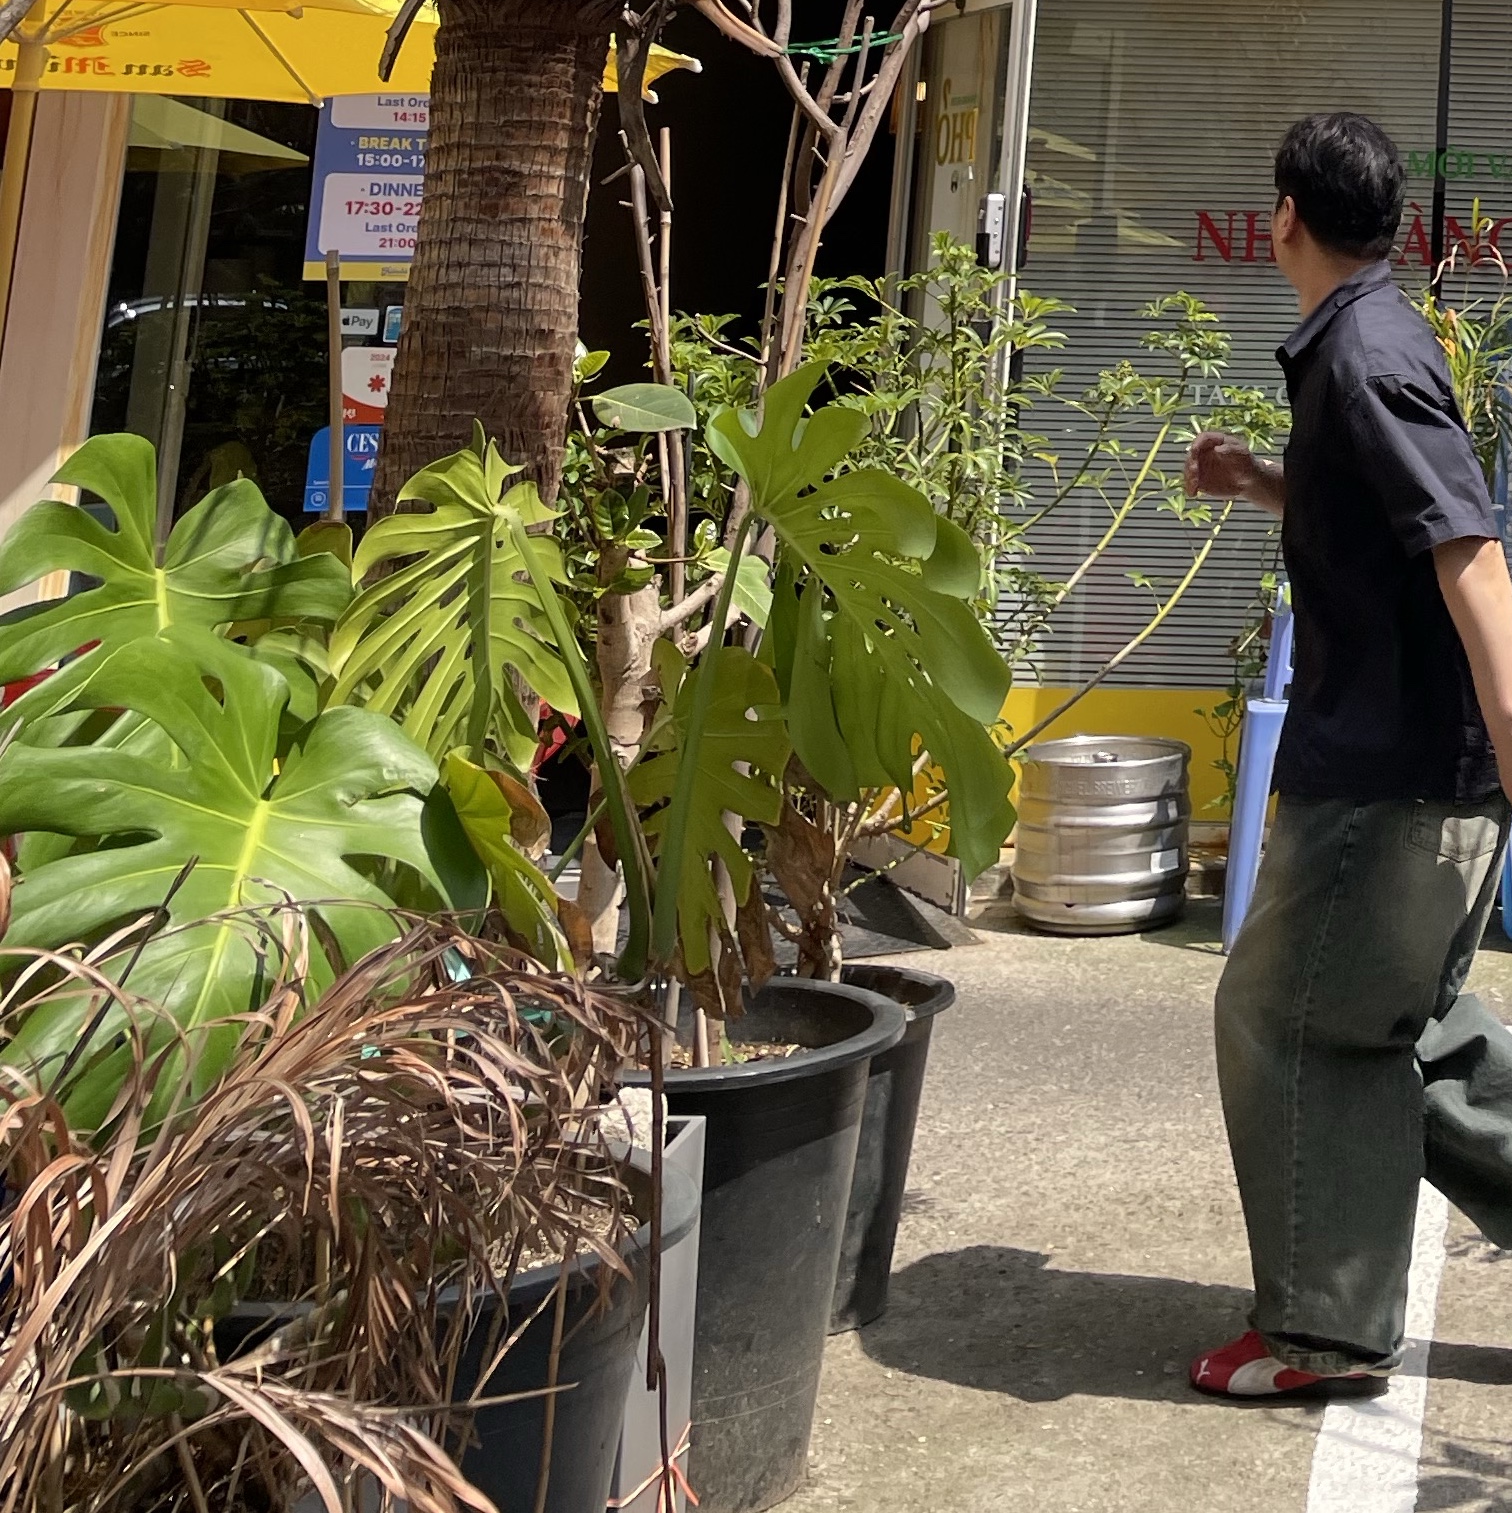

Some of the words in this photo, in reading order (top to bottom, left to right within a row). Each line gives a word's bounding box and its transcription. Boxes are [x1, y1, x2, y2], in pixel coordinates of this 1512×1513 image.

[377, 96, 404, 107] Last
[408, 97, 430, 108] Ord
[393, 112, 427, 123] 14:15
[358, 136, 412, 150] BREAK
[356, 153, 425, 168] 15:00-17
[369, 182, 424, 197] DINNE
[345, 200, 423, 216] 17:30-22
[365, 222, 393, 233] Last
[396, 222, 418, 233] Ord
[379, 237, 416, 249] 21:00
[1192, 209, 1277, 263] NH
[351, 315, 374, 330] Pay
[346, 432, 379, 454] CES
